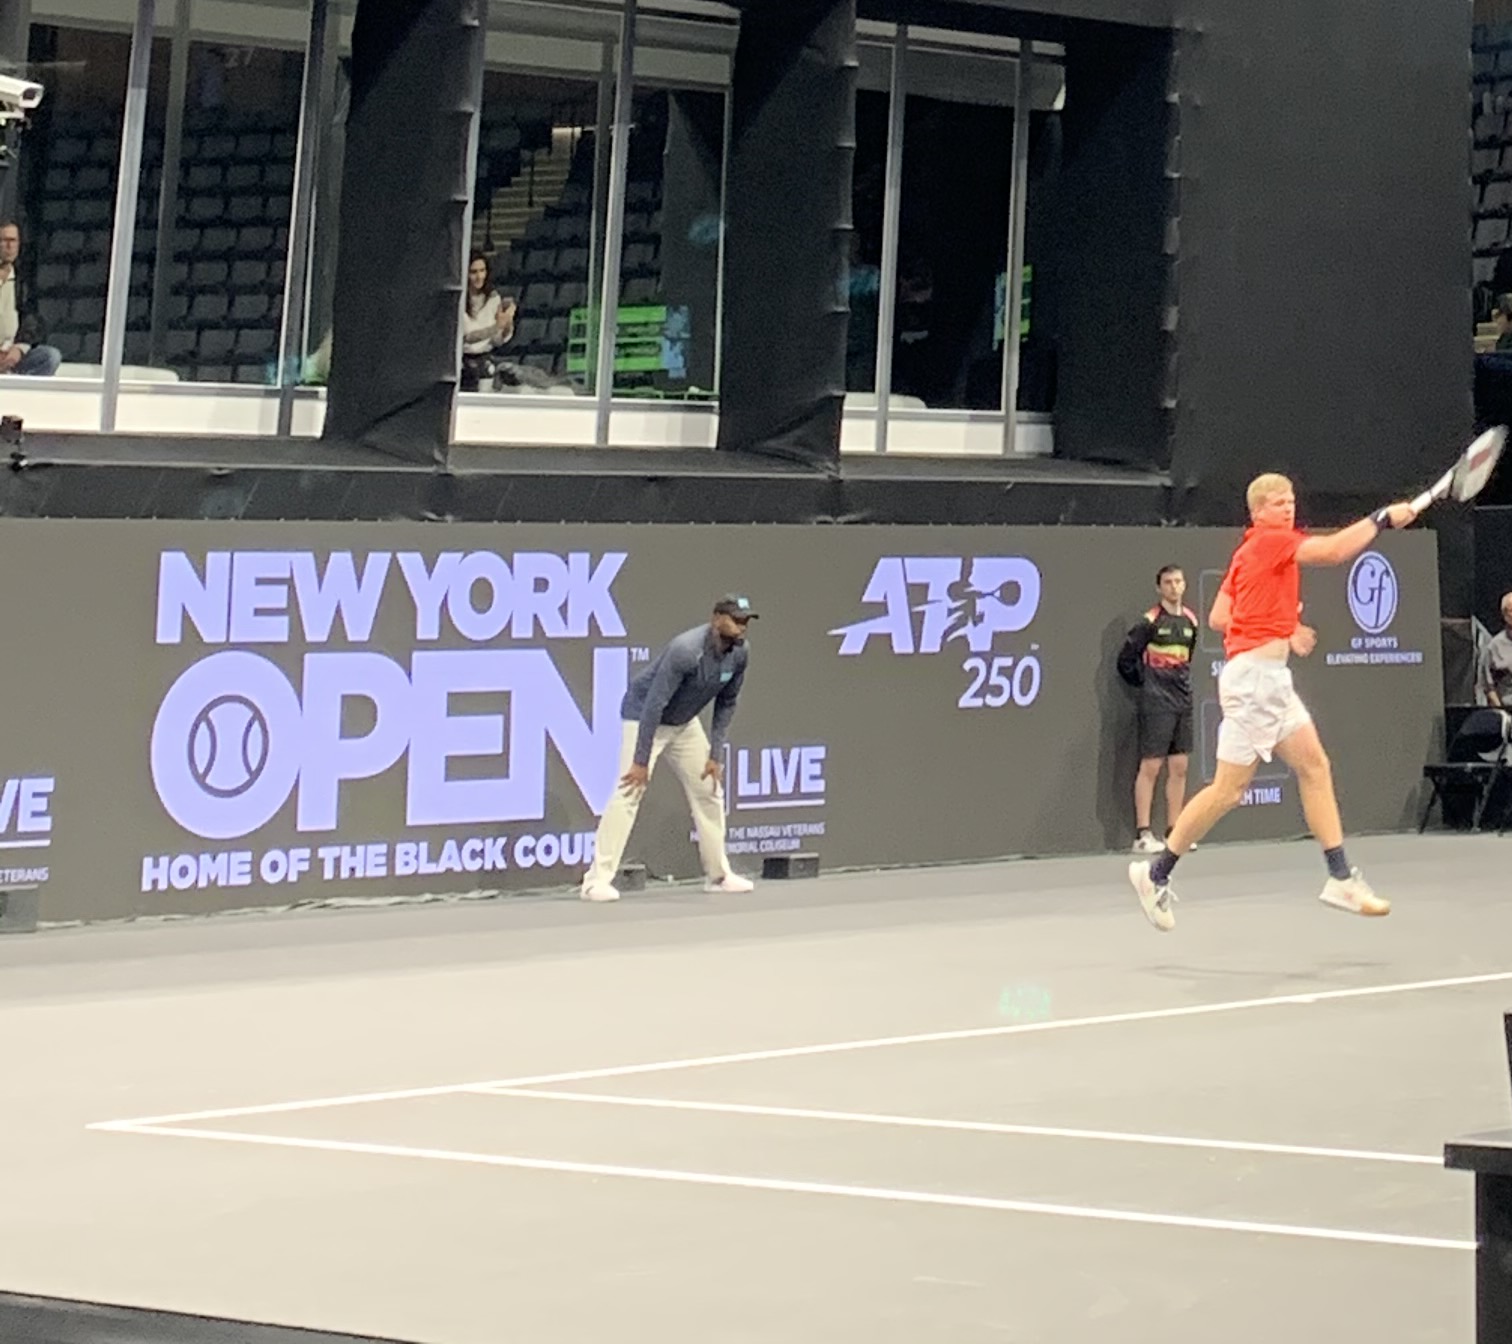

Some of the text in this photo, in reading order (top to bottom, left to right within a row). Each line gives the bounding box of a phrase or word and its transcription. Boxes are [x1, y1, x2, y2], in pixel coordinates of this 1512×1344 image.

[156, 550, 628, 644] NEW YORK
[828, 557, 1042, 655] ATP
[1364, 636, 1399, 649] SPORTS
[957, 656, 1042, 709] 250
[150, 647, 650, 840] OPEN TM
[737, 746, 827, 797] LIVE
[728, 826, 745, 839] THE
[0, 866, 49, 884] TERANS
[141, 832, 598, 892] HOME OF THE BLACK COUR
